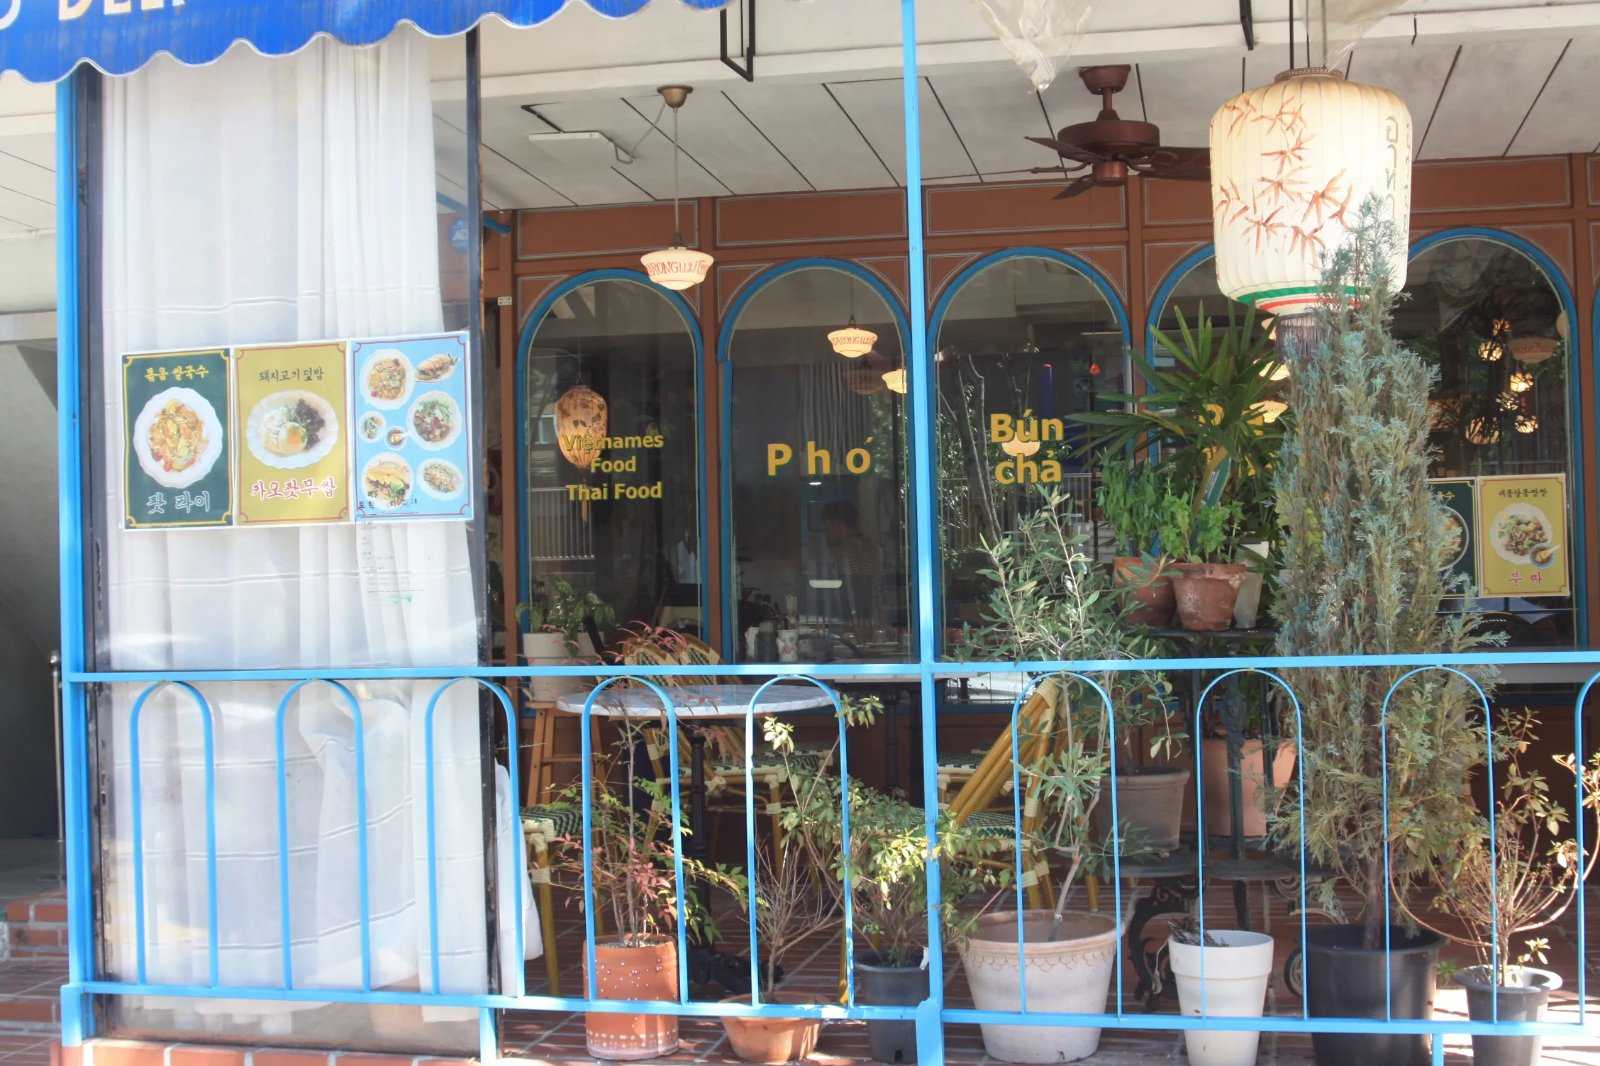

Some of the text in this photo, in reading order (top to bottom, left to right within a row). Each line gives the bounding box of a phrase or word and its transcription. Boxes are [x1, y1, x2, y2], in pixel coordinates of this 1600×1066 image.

[144, 364, 209, 382] 볶음 쌀국수
[259, 365, 325, 383] 돼지고기 덮밥
[991, 408, 1064, 443] Bún
[590, 456, 637, 473] Food
[995, 450, 1062, 485] chả
[565, 481, 662, 501] Thai Food
